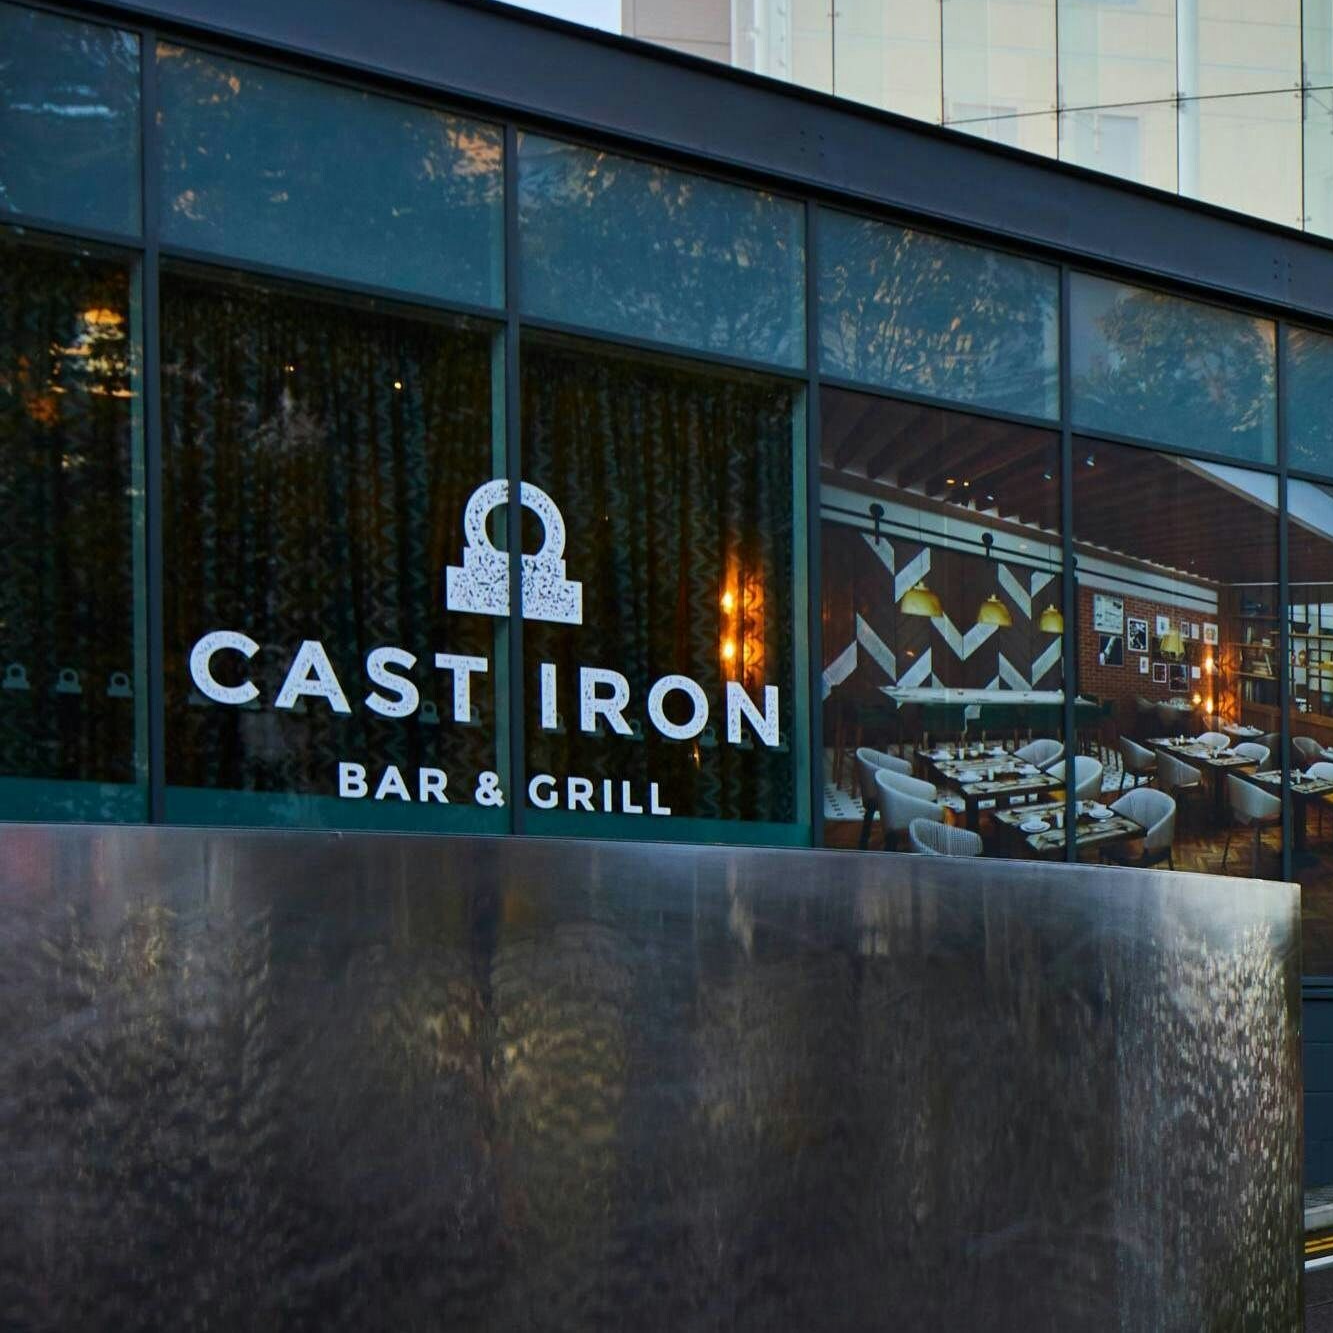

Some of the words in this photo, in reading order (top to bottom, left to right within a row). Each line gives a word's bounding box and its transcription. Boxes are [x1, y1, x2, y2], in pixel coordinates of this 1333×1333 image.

[189, 630, 489, 723] CAST
[540, 663, 780, 747] IRON
[338, 762, 449, 803] BAR
[474, 771, 506, 808] &
[528, 774, 672, 816] GRILL
